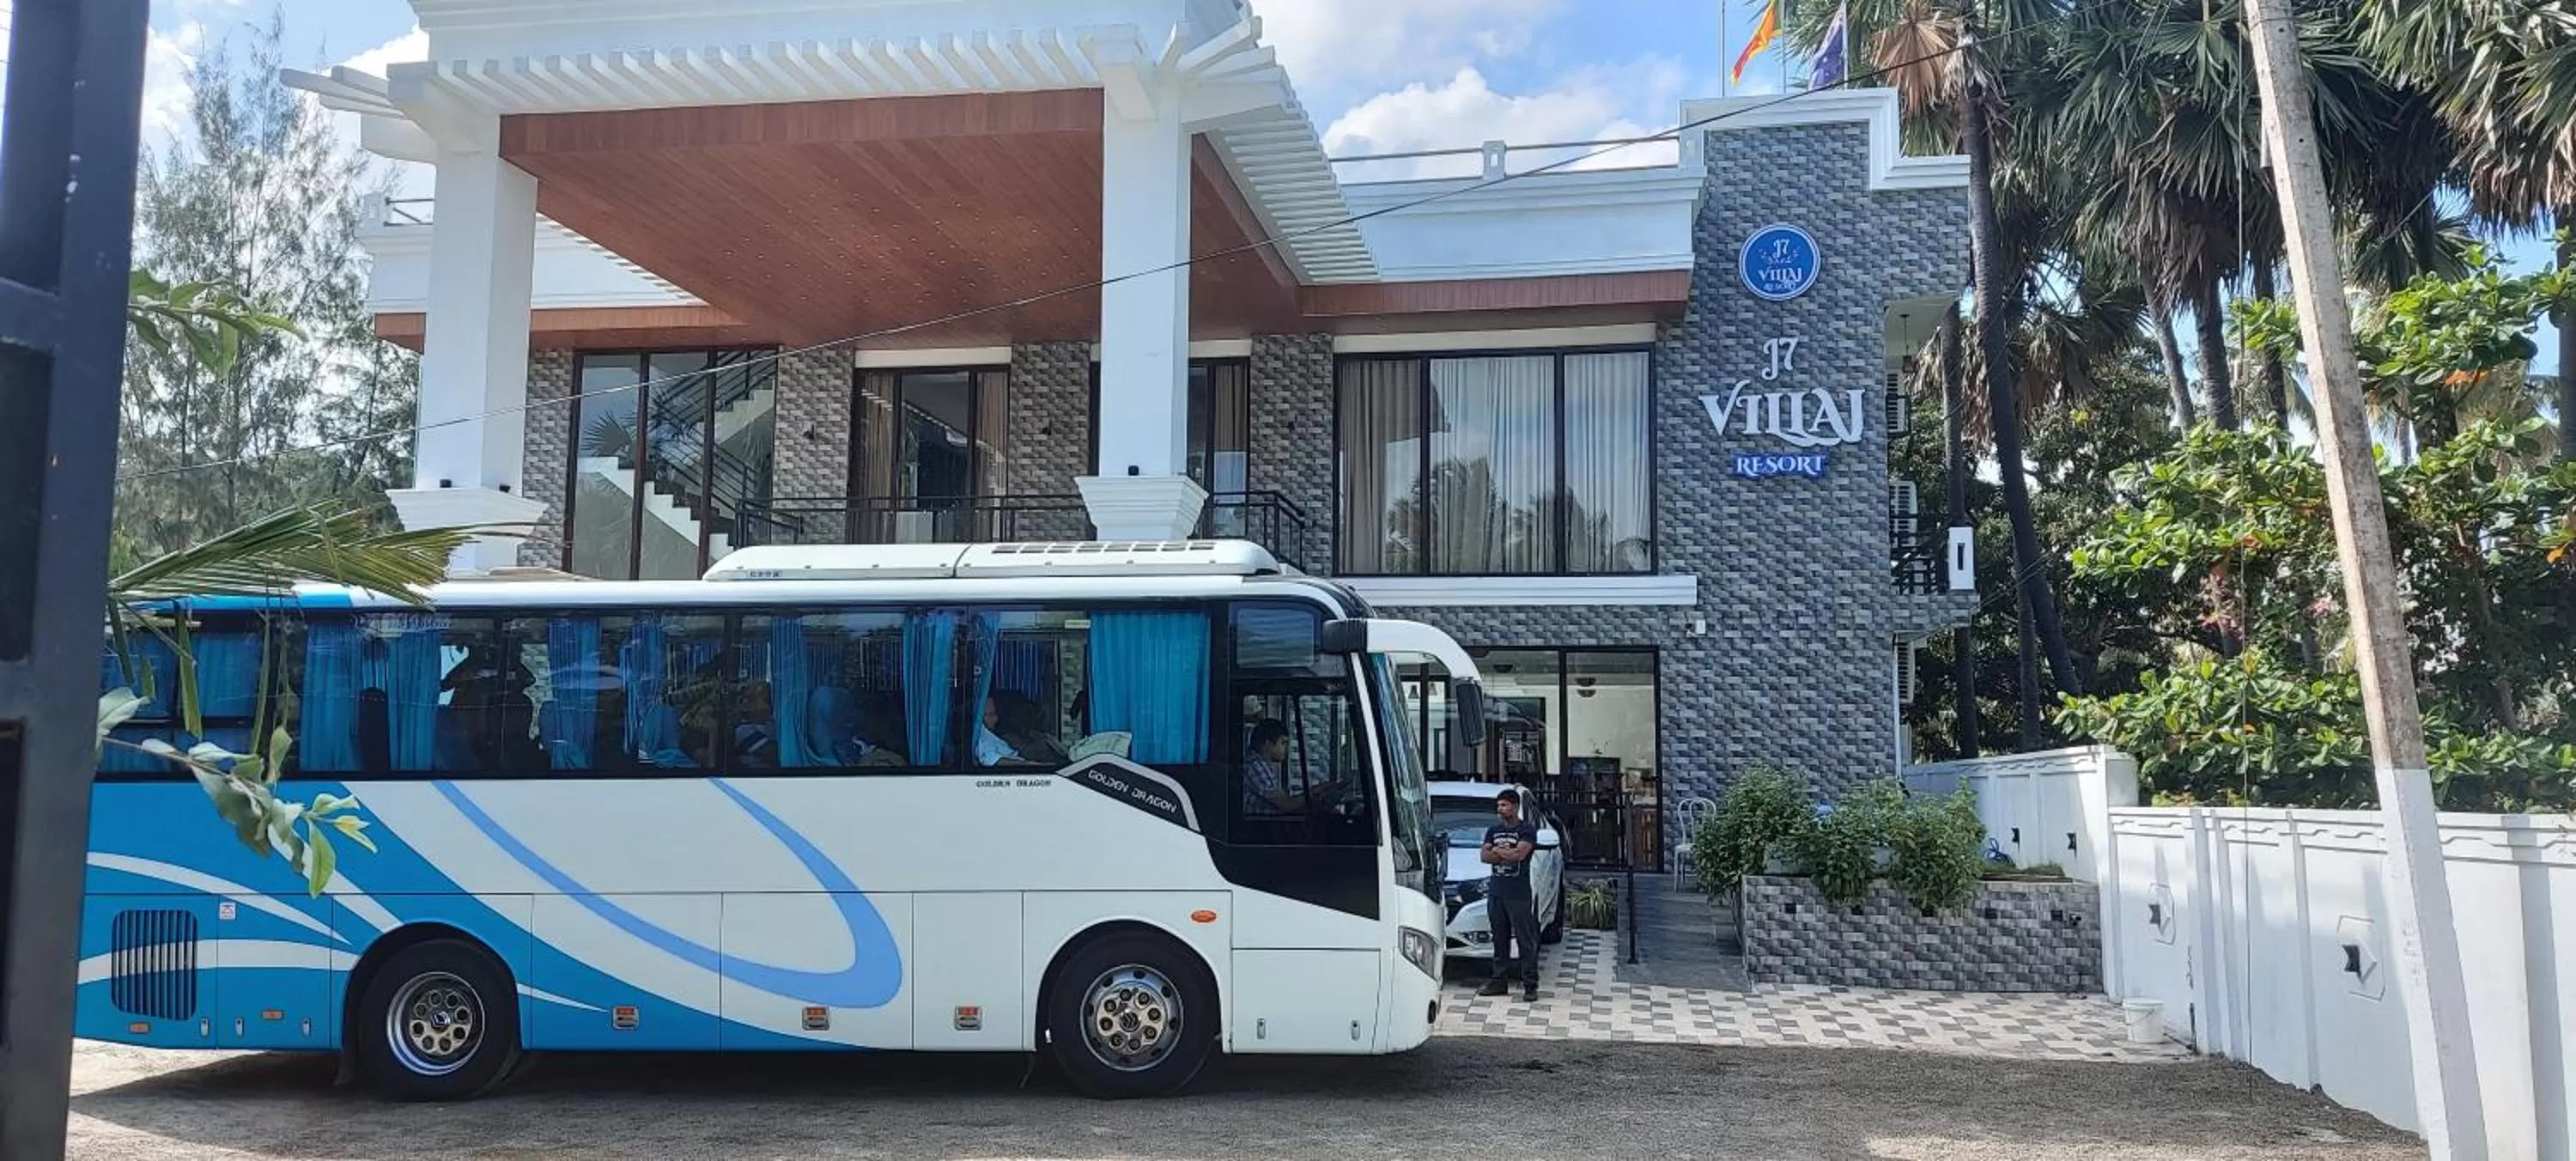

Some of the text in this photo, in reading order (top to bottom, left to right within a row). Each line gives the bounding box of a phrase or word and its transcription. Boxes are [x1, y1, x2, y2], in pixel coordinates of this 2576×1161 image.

[1761, 336, 1799, 380] J7
[1698, 380, 1865, 447] VILLAJ
[1736, 456, 1825, 477] RESORT
[1088, 769, 1177, 813] GOLDEN DRAGON
